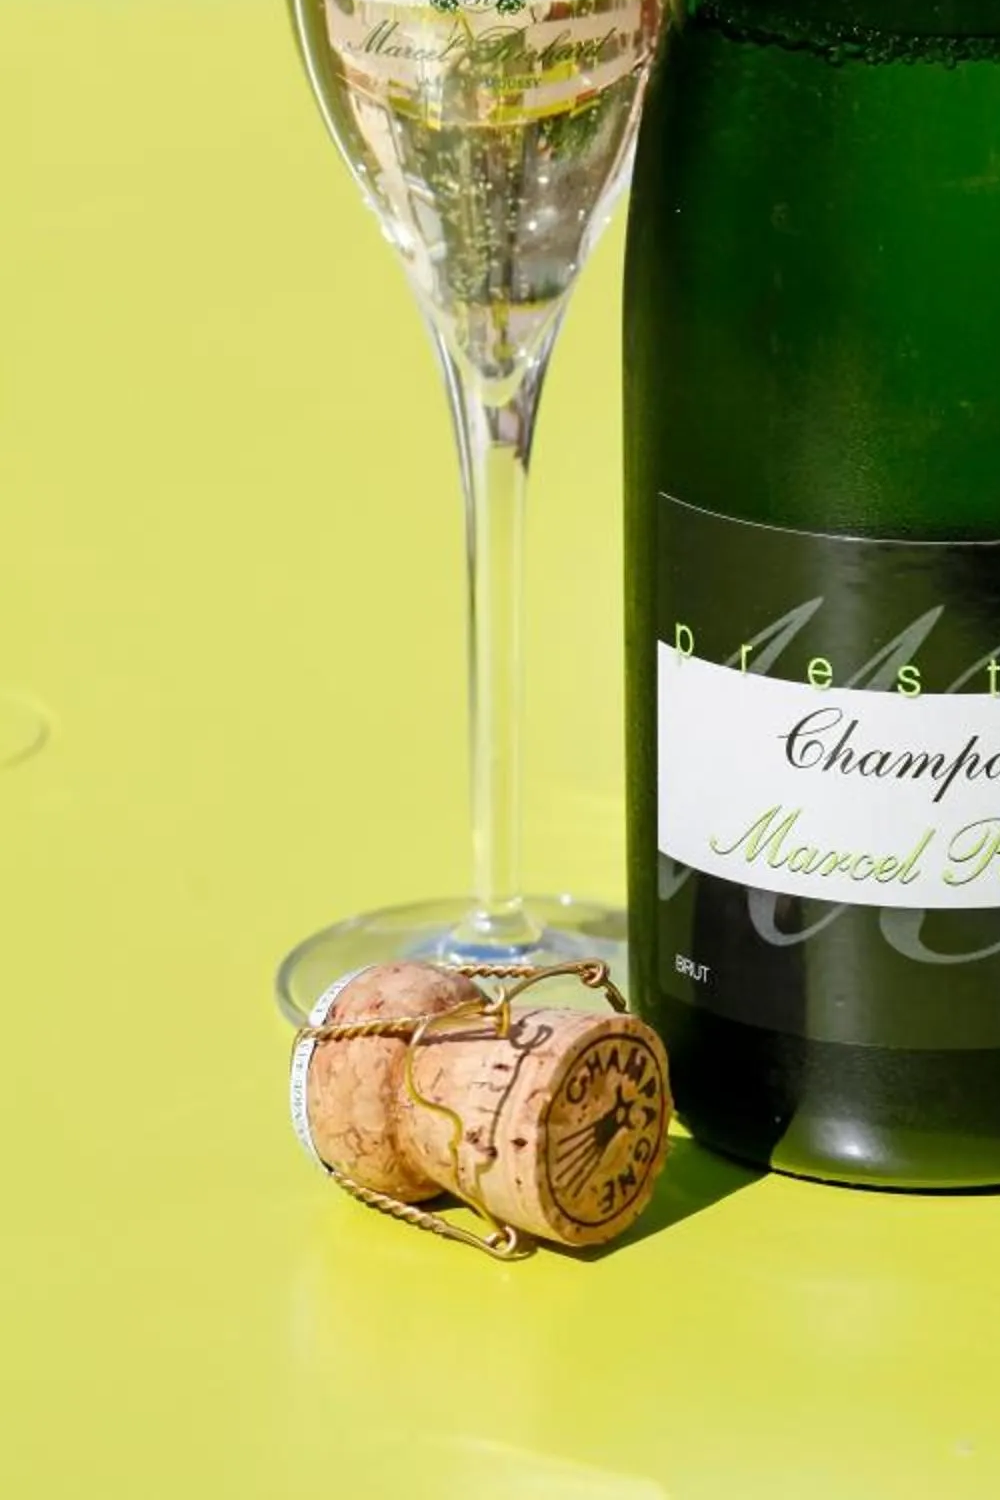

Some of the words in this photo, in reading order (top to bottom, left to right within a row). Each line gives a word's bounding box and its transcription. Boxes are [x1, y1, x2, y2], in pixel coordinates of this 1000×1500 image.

[709, 803, 937, 886] Marcel
[675, 953, 711, 984] BRUT
[565, 1046, 657, 1215] CHAMPAGNE
